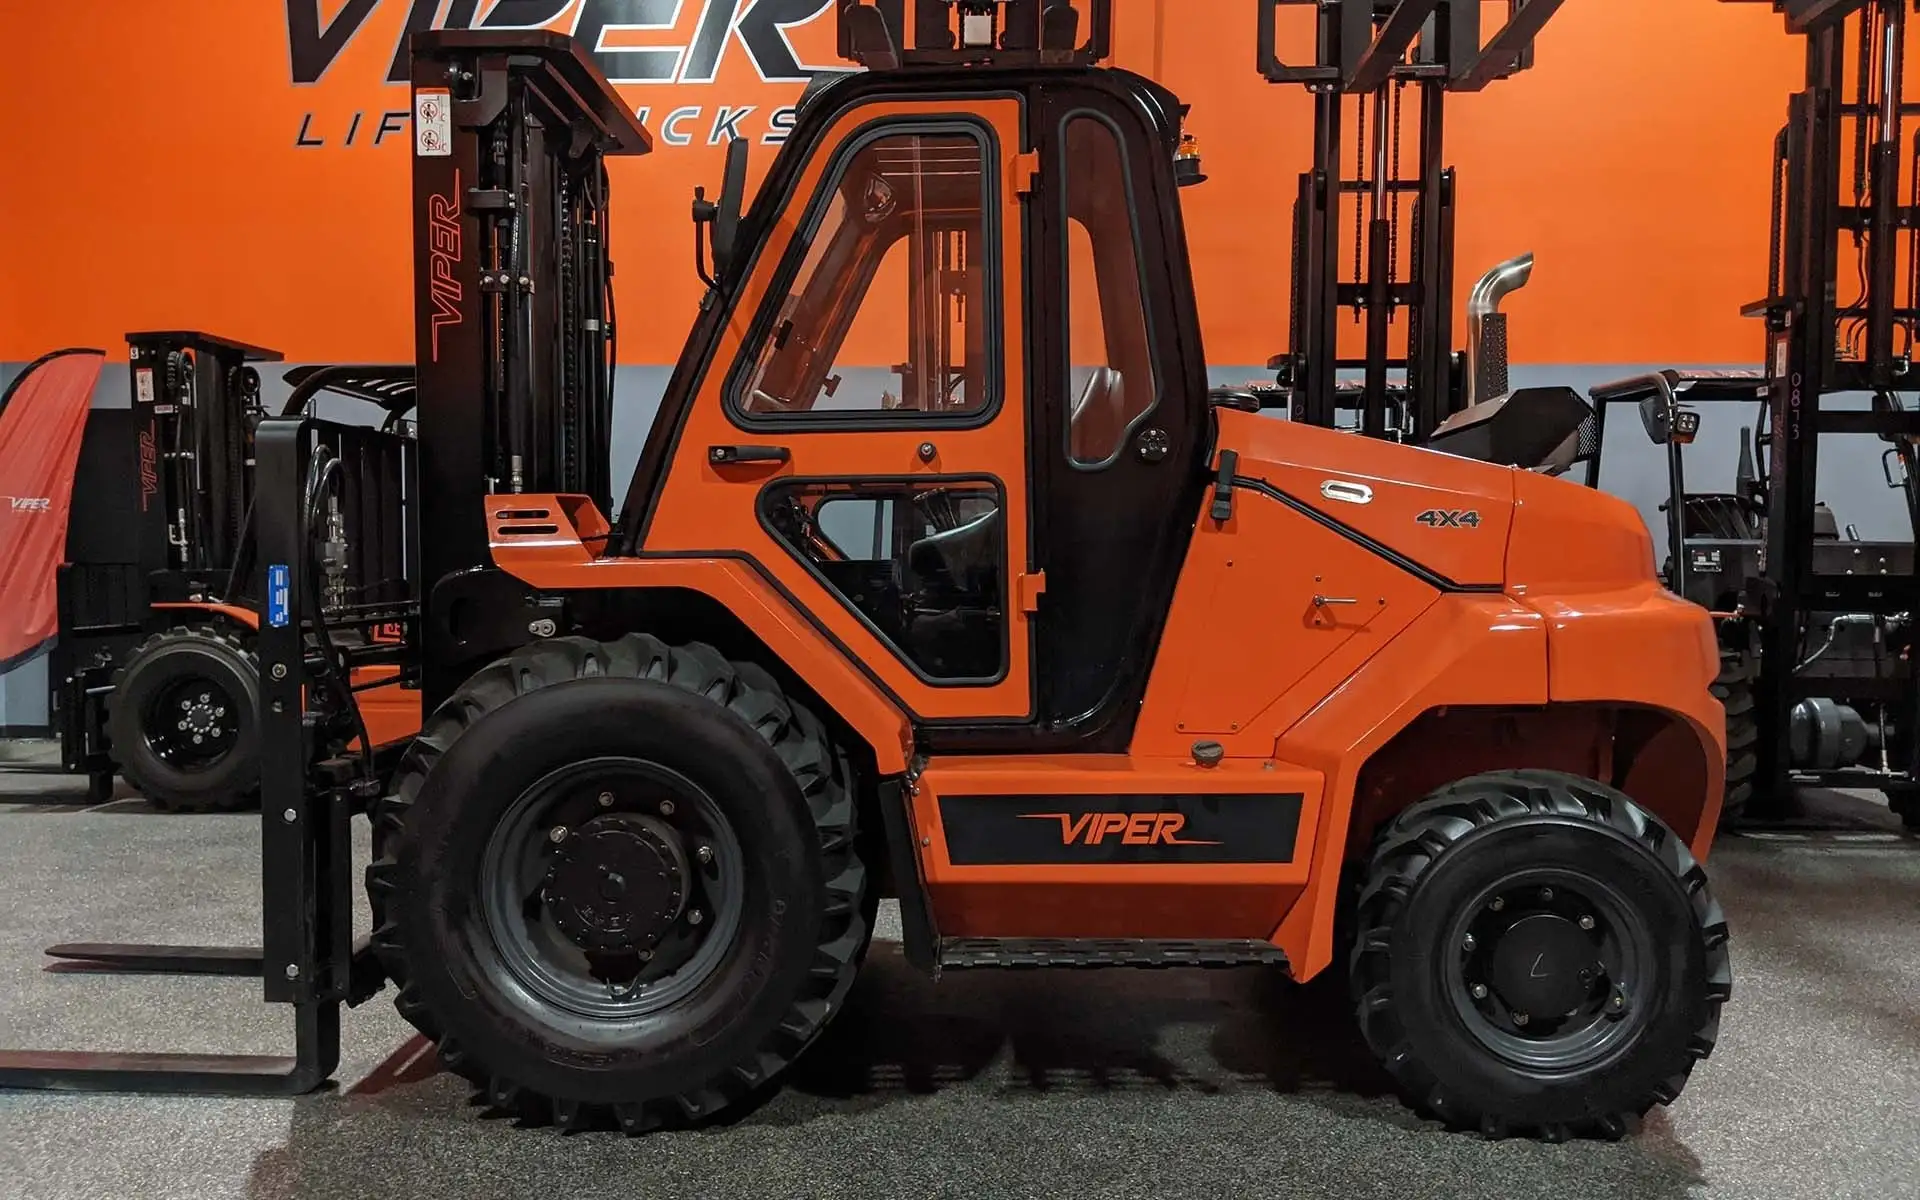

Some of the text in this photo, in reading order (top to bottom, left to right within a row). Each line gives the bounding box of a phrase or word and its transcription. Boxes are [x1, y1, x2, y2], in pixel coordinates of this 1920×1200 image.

[285, 0, 868, 84] VIER
[295, 111, 411, 147] LIF
[428, 168, 461, 363] VIPER
[139, 419, 158, 512] VIPER
[1, 495, 52, 510] VIPER
[1016, 812, 1224, 845] VIPER
